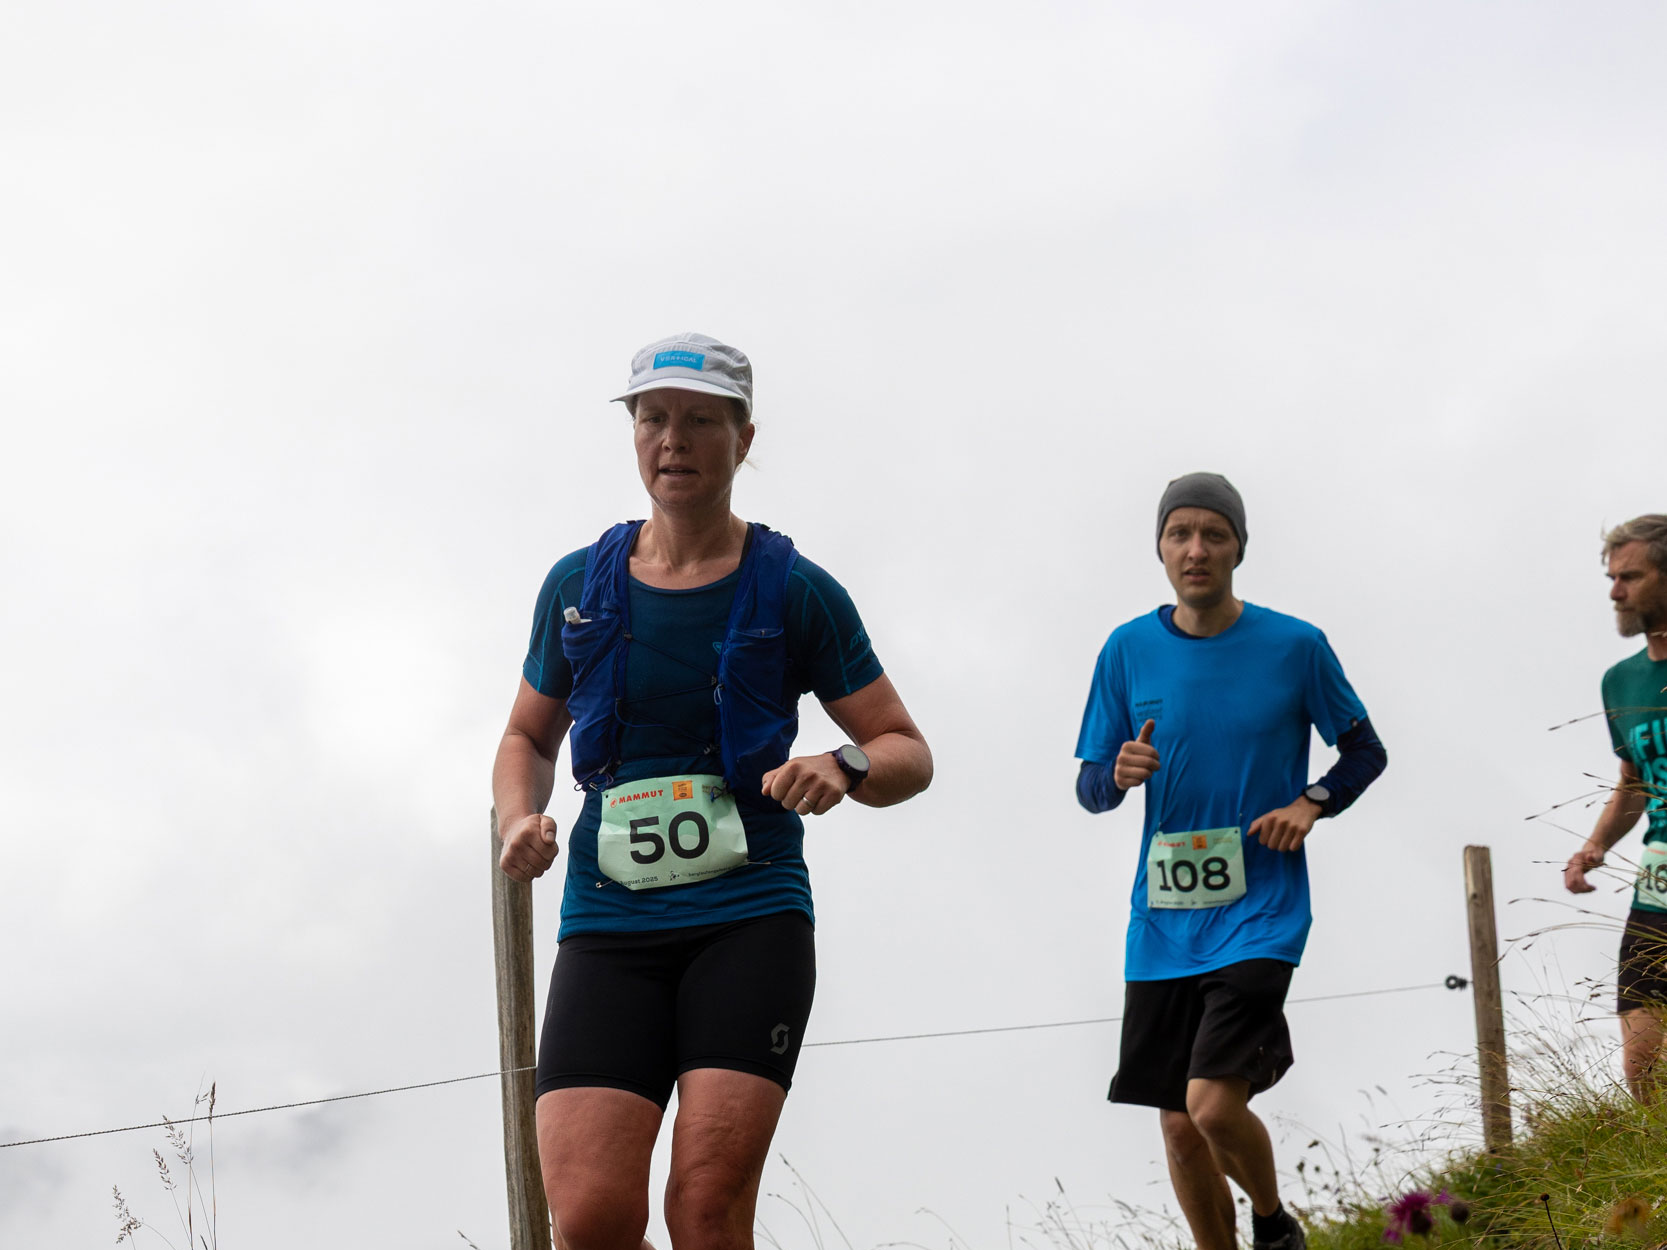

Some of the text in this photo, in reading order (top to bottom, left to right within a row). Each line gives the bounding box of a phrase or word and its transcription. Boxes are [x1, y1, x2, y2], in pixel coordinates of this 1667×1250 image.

[618, 789, 664, 804] MAMMUT
[629, 811, 709, 865] 50
[641, 876, 659, 884] 2025
[1157, 856, 1231, 893] 108
